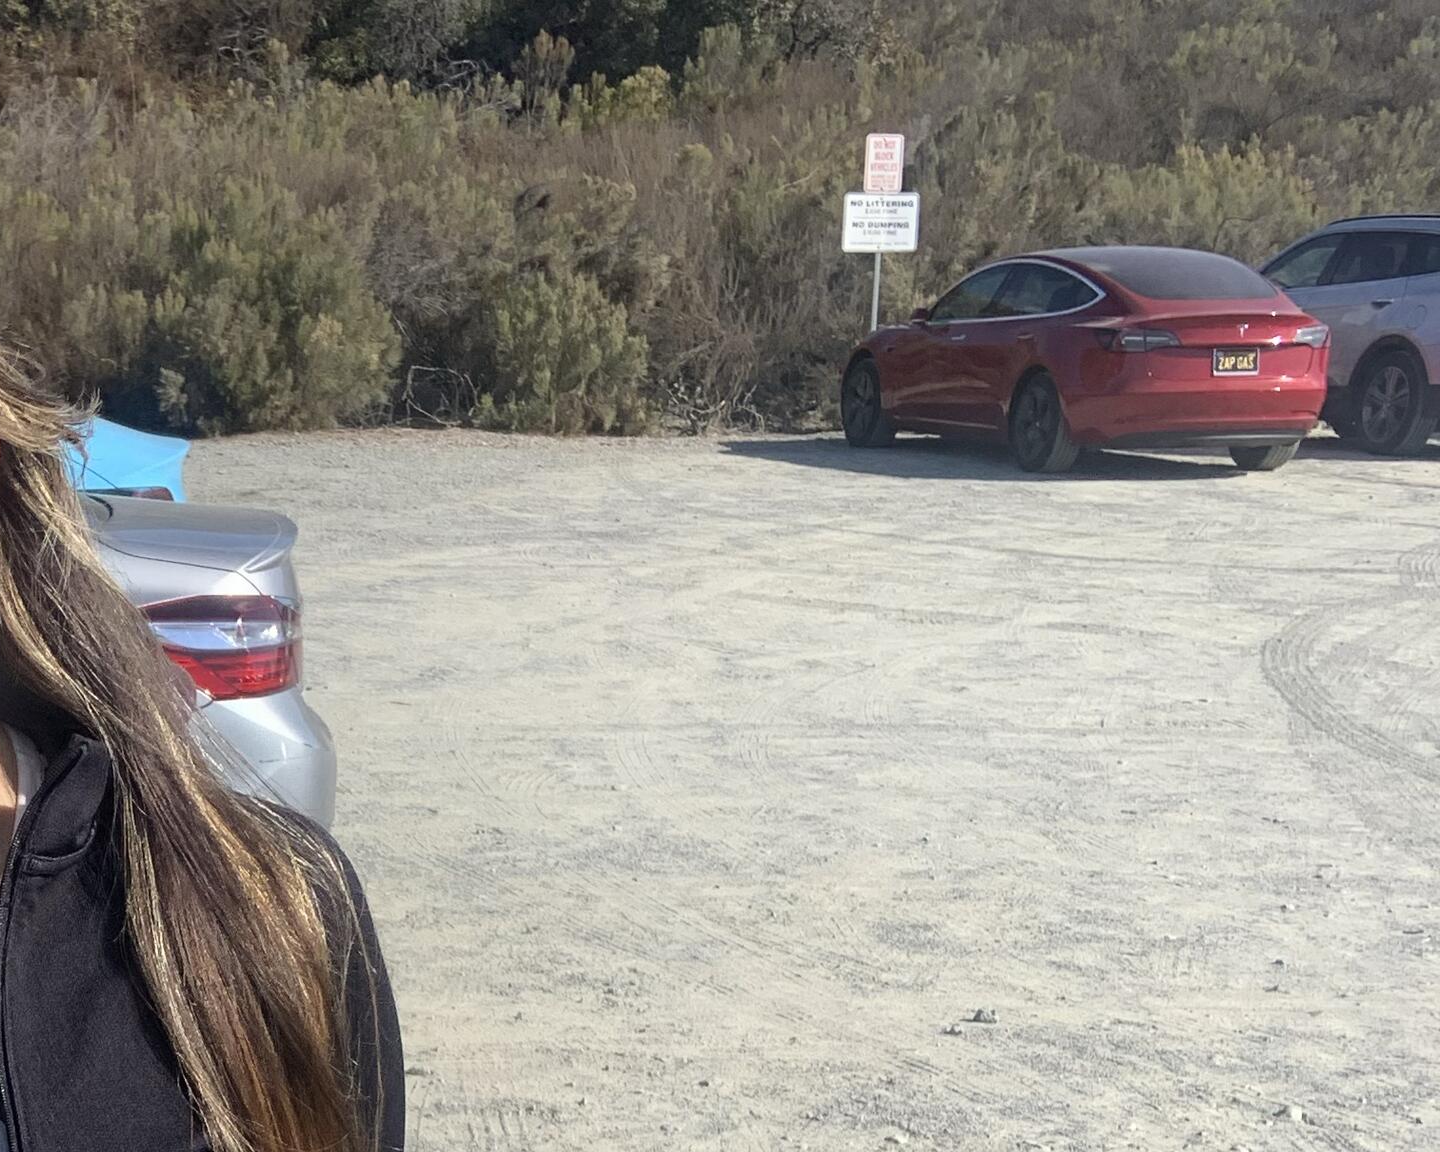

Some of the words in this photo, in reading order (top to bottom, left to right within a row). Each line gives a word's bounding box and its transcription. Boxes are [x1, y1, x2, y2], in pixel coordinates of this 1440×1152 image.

[867, 221, 910, 229] DUMPING
[1218, 356, 1236, 370] ZAP
[1236, 356, 1254, 369] GAS
